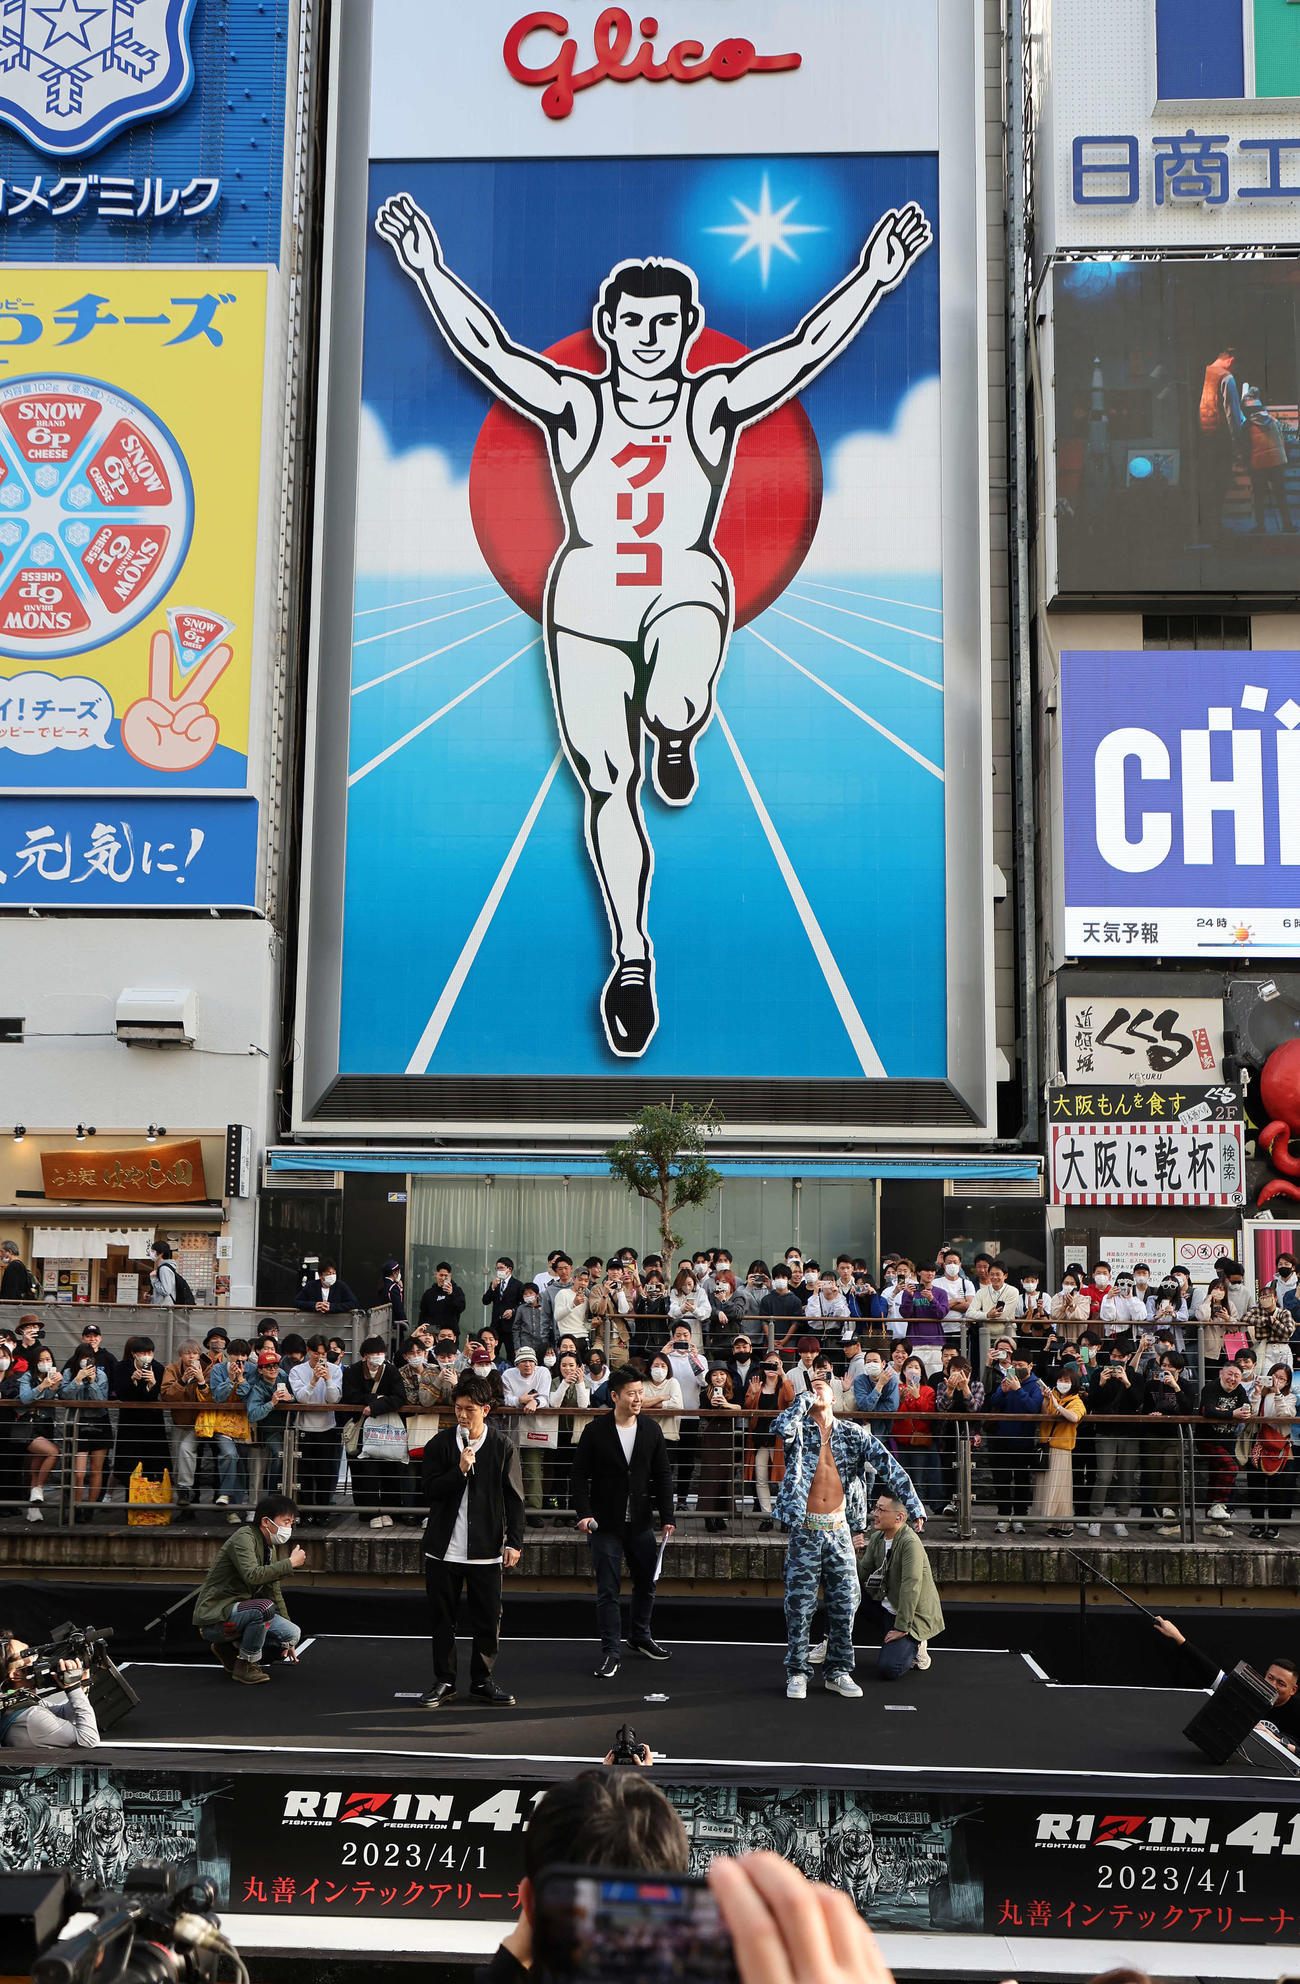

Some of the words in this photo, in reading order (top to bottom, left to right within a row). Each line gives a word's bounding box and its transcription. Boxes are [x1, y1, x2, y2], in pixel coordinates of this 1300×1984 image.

[503, 7, 802, 119] Glico
[0, 174, 220, 216] メグミルク
[18, 403, 86, 419] SNOW
[28, 449, 68, 459] CHEESE
[120, 435, 165, 492] SNOW
[90, 467, 114, 503] CHEESE
[610, 435, 671, 586] グリコ
[84, 528, 112, 565] CHEESE
[21, 572, 62, 582] CHEESE
[114, 538, 159, 602] SNOW
[3, 612, 71, 629] SNOW
[183, 617, 216, 632] SNOW
[183, 641, 202, 649] CHEESE
[1083, 922, 1159, 944] 天気予報
[1196, 917, 1227, 928] 24時
[1074, 1006, 1094, 1073] 道頓堀
[1095, 1008, 1193, 1071] くくる
[1053, 1092, 1186, 1116] 大阪もんを食す
[1215, 1106, 1238, 1119] 2F
[1062, 1136, 1215, 1191] 大阪に乾杯
[1222, 1145, 1236, 1180] 検索
[282, 1819, 333, 1827] FIGHTING
[383, 1822, 448, 1830] FEDERATION
[341, 1841, 487, 1872] 2023/4/1
[1034, 1842, 1087, 1850] FIGHTING
[1138, 1845, 1205, 1853] FEDERATION
[1097, 1865, 1247, 1896] 2023/4/1
